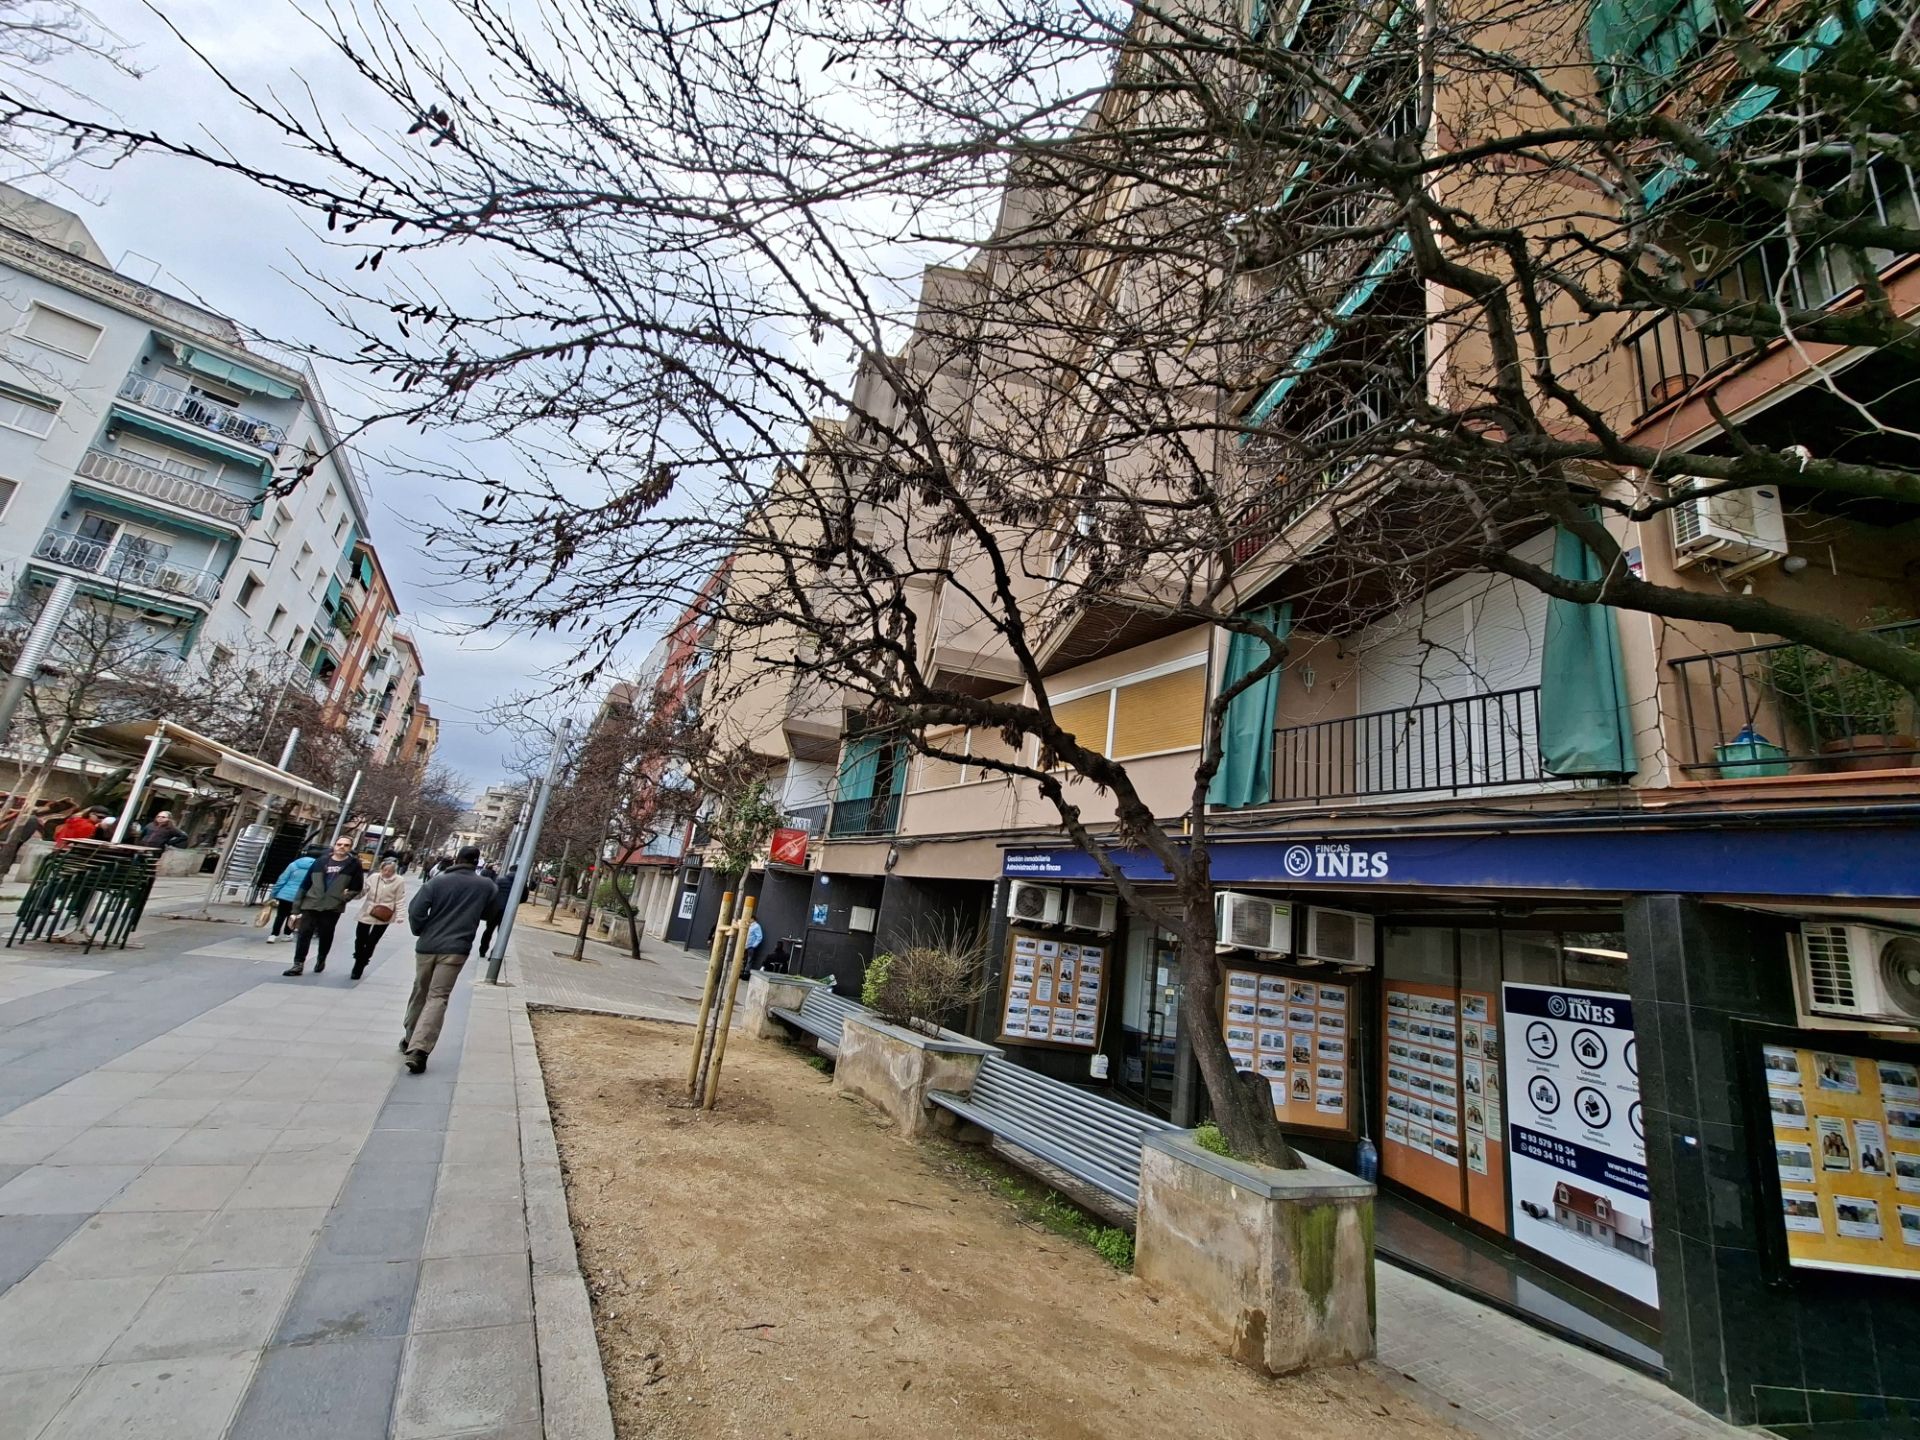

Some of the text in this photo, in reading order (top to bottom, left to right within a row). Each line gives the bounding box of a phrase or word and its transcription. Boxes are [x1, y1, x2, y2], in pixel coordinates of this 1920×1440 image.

[1315, 844, 1351, 853] FINCAS
[1006, 863, 1038, 871] Administración
[1046, 863, 1061, 871] fincas
[1315, 852, 1389, 878] INES
[1568, 1002, 1616, 1025] INES
[1528, 1134, 1576, 1157] 93 579 19 34
[1528, 1145, 1542, 1157] 629
[1543, 1150, 1553, 1160] 34
[1555, 1154, 1565, 1165] 15
